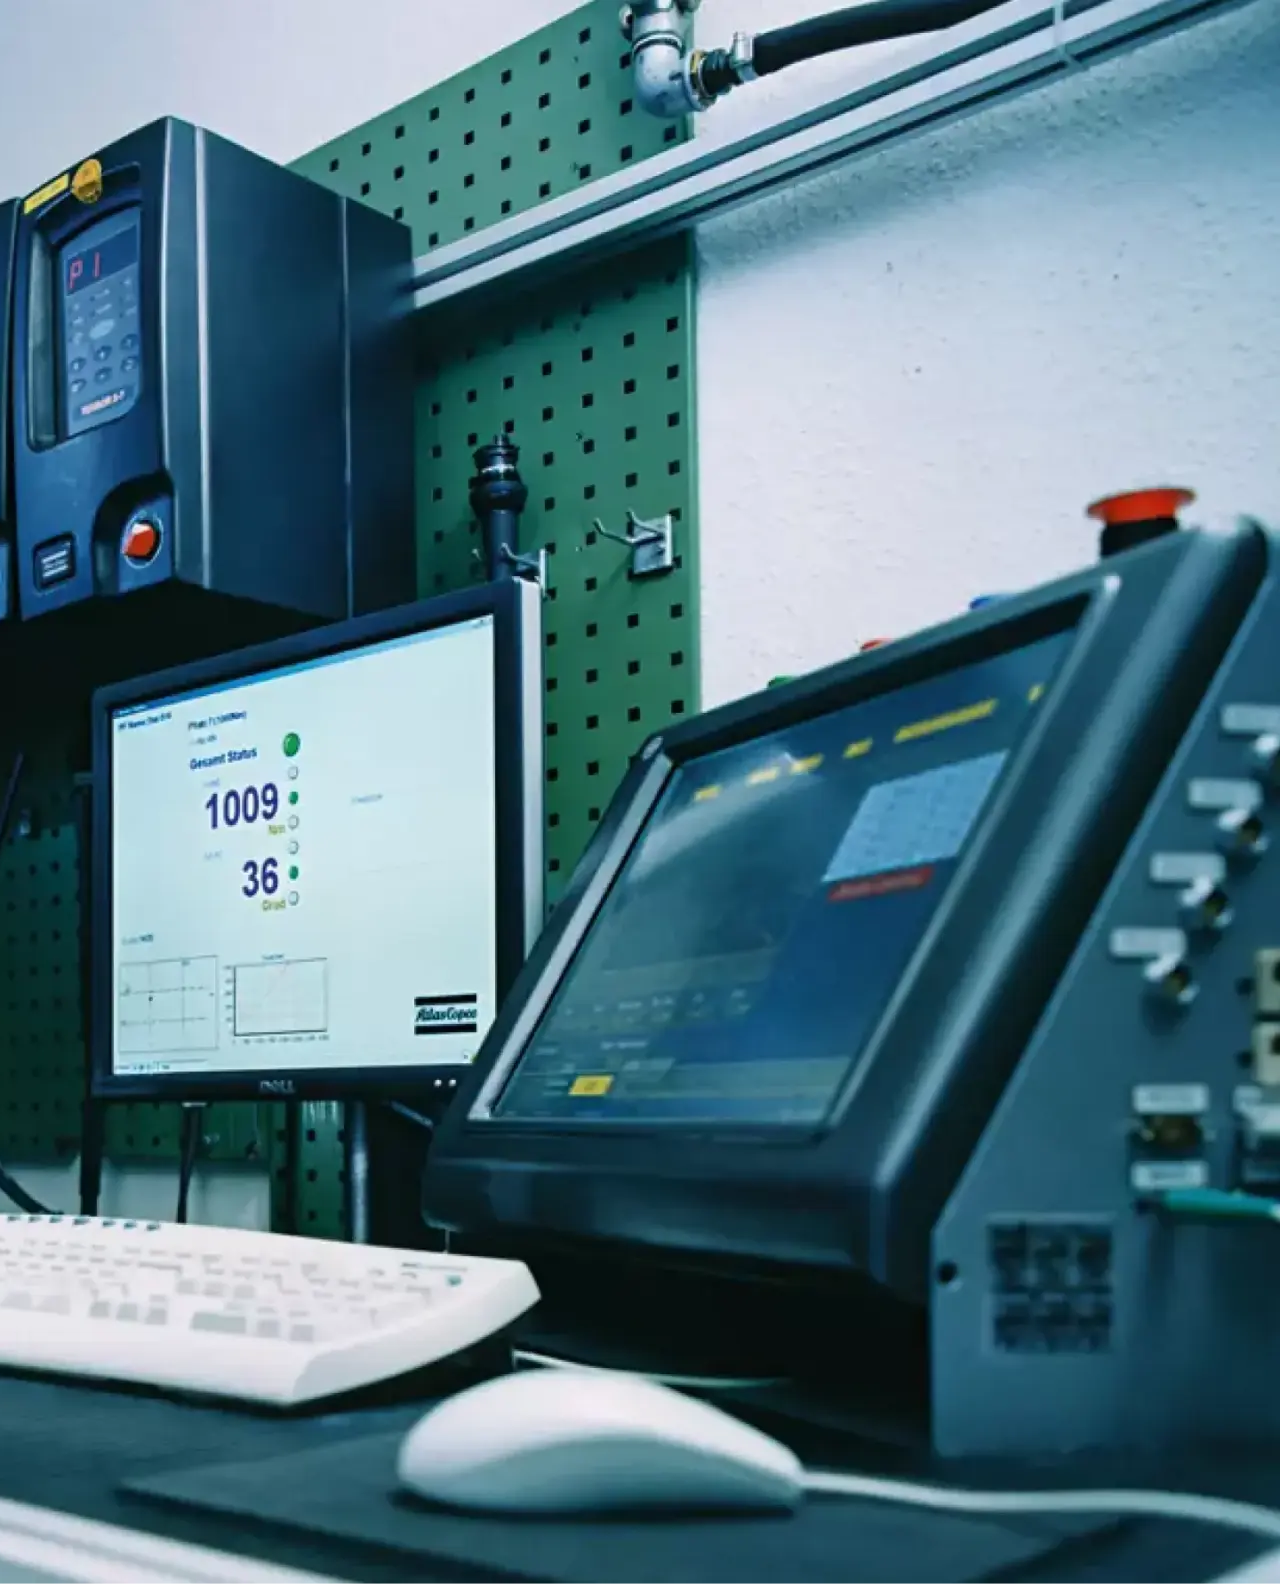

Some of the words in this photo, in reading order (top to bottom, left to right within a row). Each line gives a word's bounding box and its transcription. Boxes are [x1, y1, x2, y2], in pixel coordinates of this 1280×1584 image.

[227, 747, 258, 763] Status
[205, 782, 279, 829] 1009
[242, 857, 279, 898] 36
